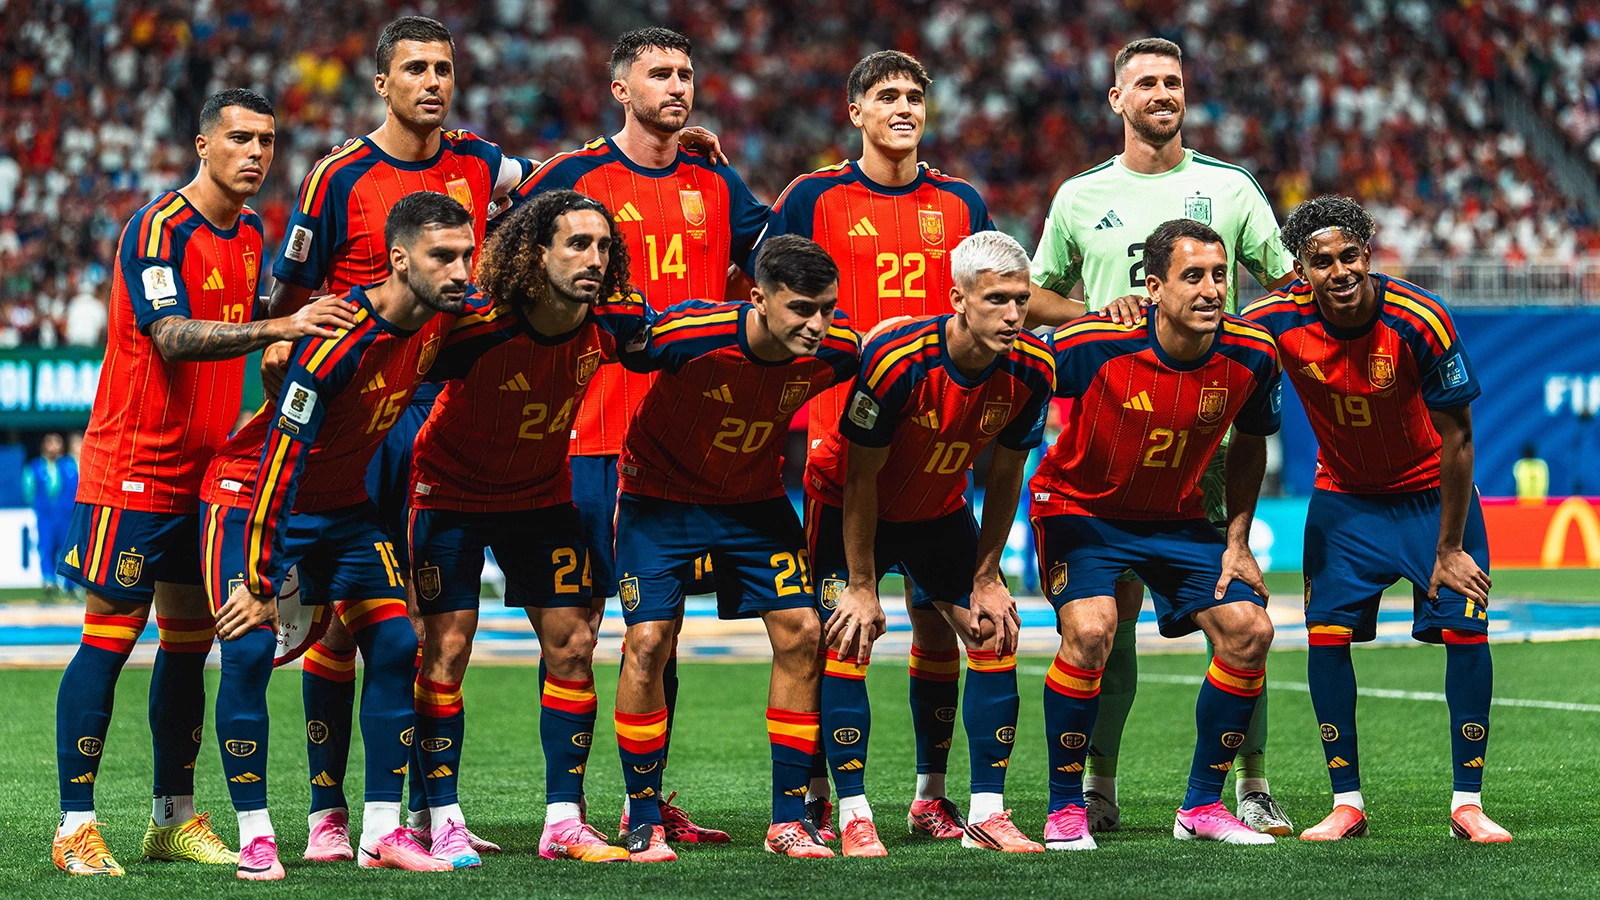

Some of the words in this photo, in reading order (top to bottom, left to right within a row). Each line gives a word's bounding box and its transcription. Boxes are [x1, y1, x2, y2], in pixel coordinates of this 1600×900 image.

[646, 234, 687, 281] 14
[876, 252, 926, 298] 22
[36, 361, 102, 409] ARA
[366, 389, 408, 434] 15
[518, 397, 575, 440] 24
[1330, 393, 1372, 427] 19
[713, 417, 774, 454] 20
[1142, 427, 1188, 468] 21
[924, 441, 970, 474] 10
[769, 548, 815, 597] 20
[279, 621, 298, 631] IÓN
